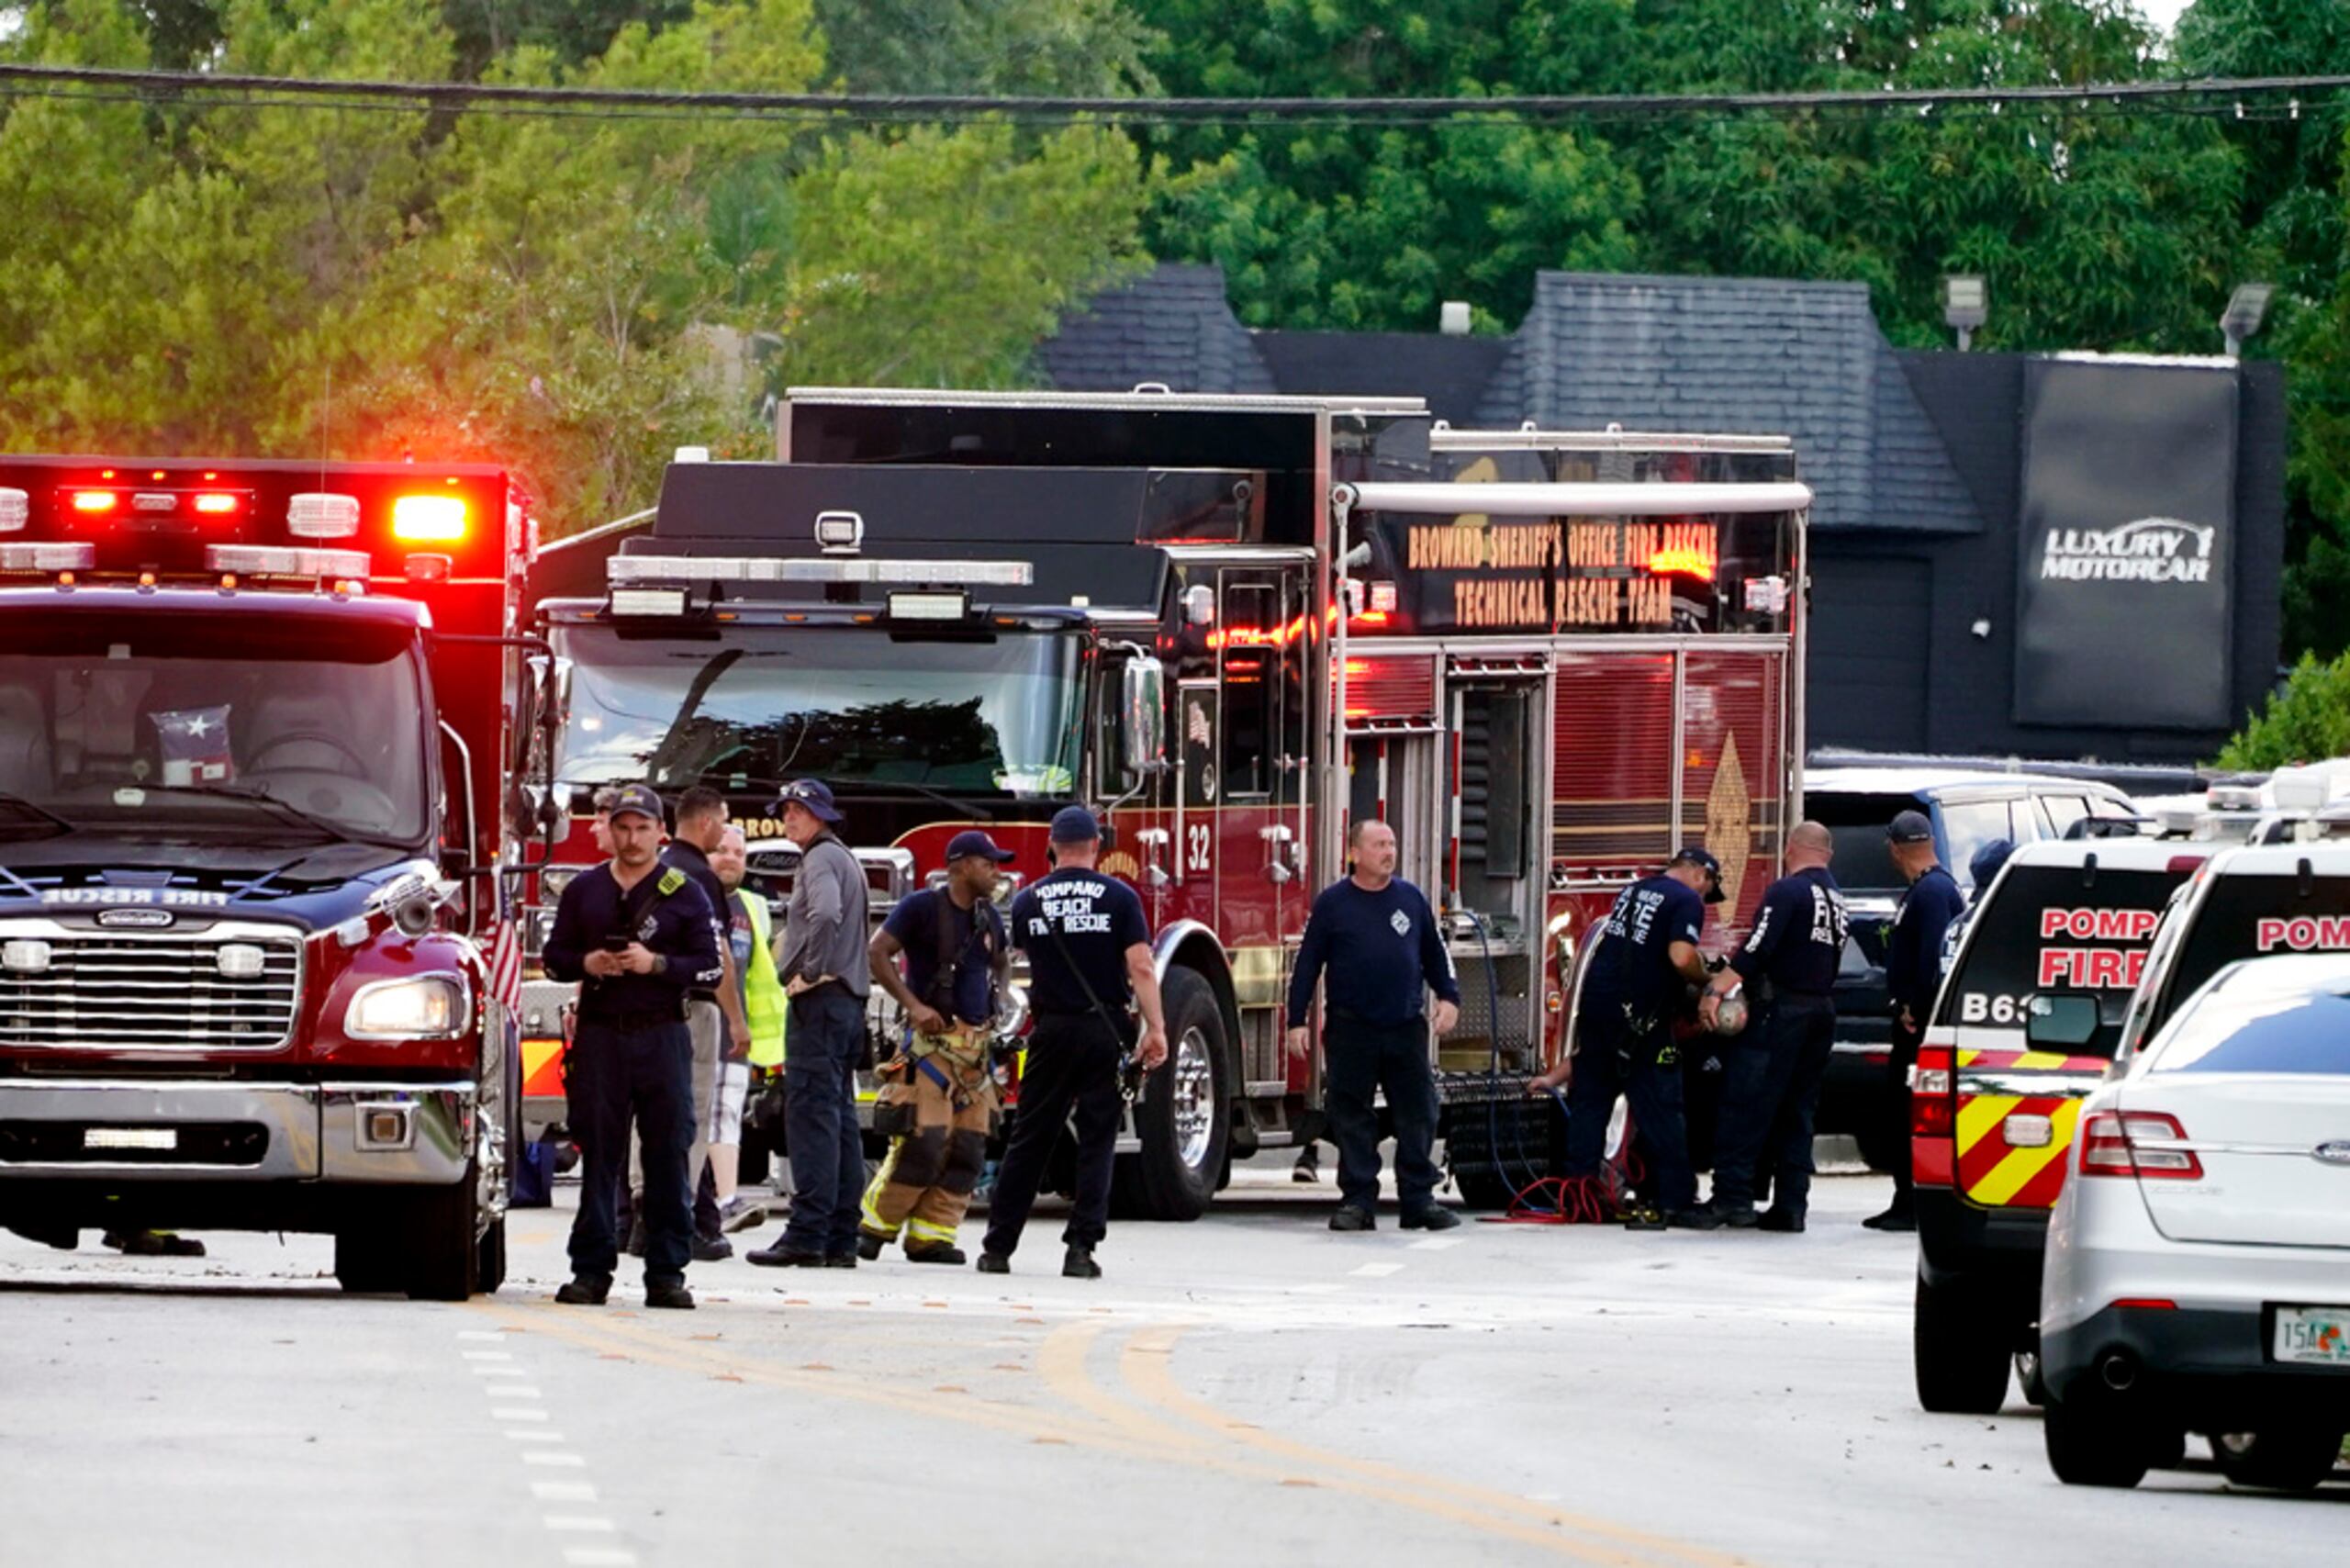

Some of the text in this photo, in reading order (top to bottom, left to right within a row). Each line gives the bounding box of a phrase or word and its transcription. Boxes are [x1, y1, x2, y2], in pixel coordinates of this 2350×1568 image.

[1408, 522, 1718, 569] BROWARD SHERIFF'S OFFICE FIRE RESCUE
[2044, 528, 2185, 557] LUXURY
[2041, 556, 2210, 582] MOTORCAR
[1454, 577, 1673, 626] TECHNICAL RESCUE TEAM
[1188, 824, 1210, 870] 32
[1041, 897, 1092, 918] BEACH
[1063, 913, 1112, 933] RESCUE
[2040, 907, 2165, 940] POMP
[2257, 914, 2350, 951] POM
